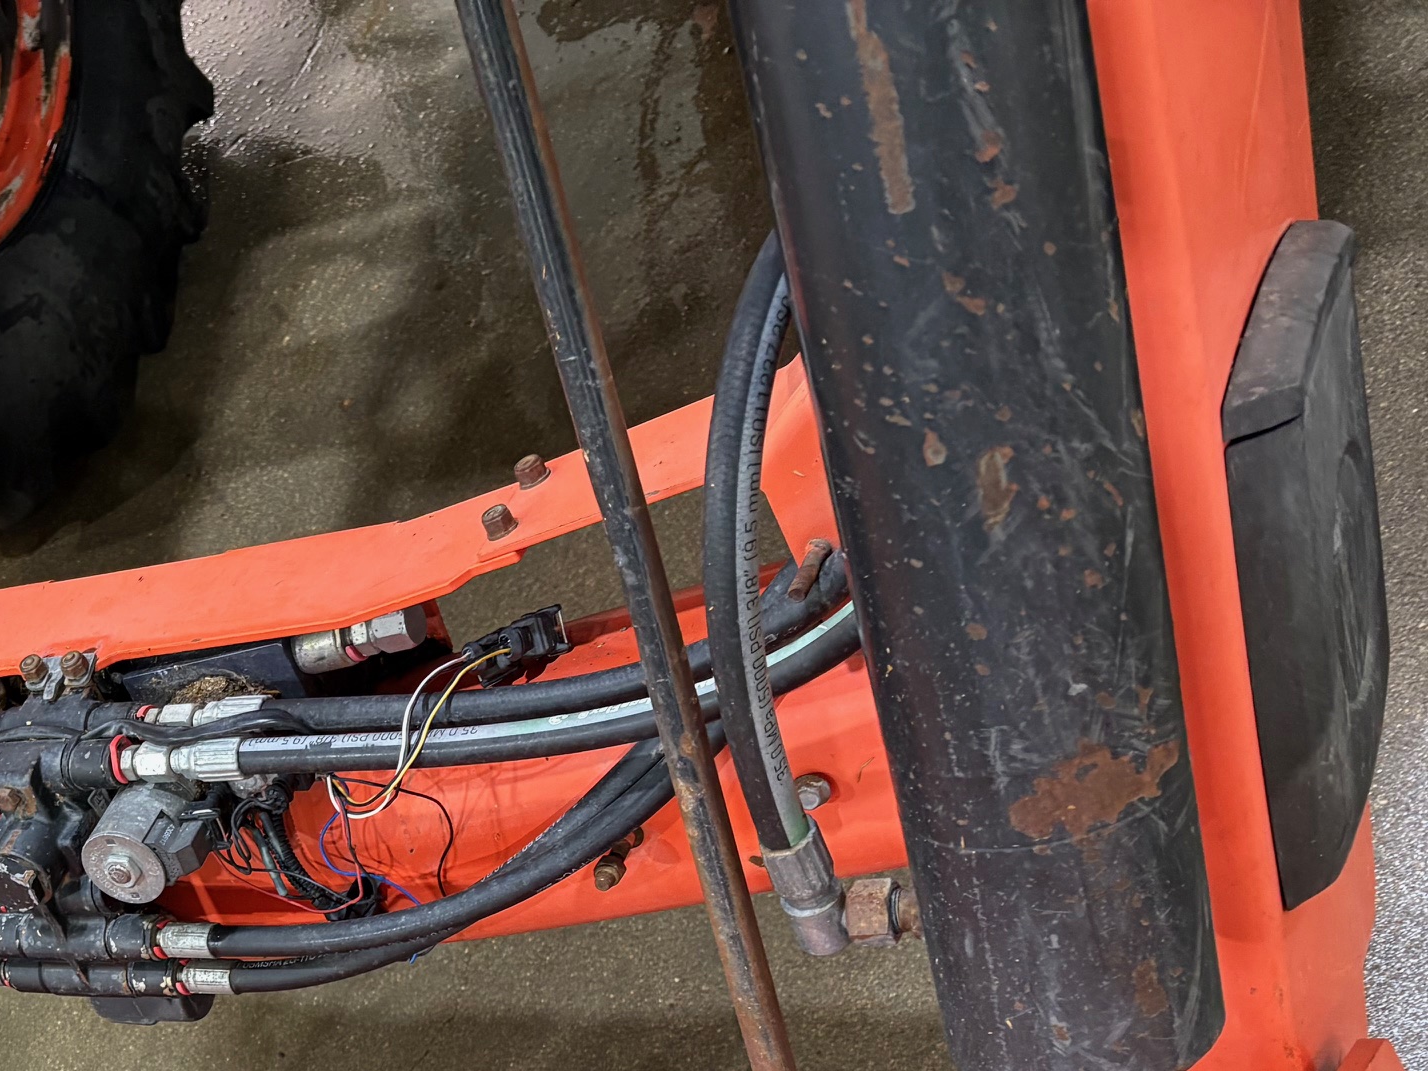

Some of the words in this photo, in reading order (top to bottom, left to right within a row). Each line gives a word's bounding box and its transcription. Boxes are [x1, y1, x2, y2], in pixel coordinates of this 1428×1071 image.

[746, 463, 762, 513] mm)
[743, 519, 759, 562] (95
[747, 613, 765, 655] PSI)
[752, 654, 773, 710] (5000
[763, 709, 785, 748] MPa
[769, 748, 789, 782] 350
